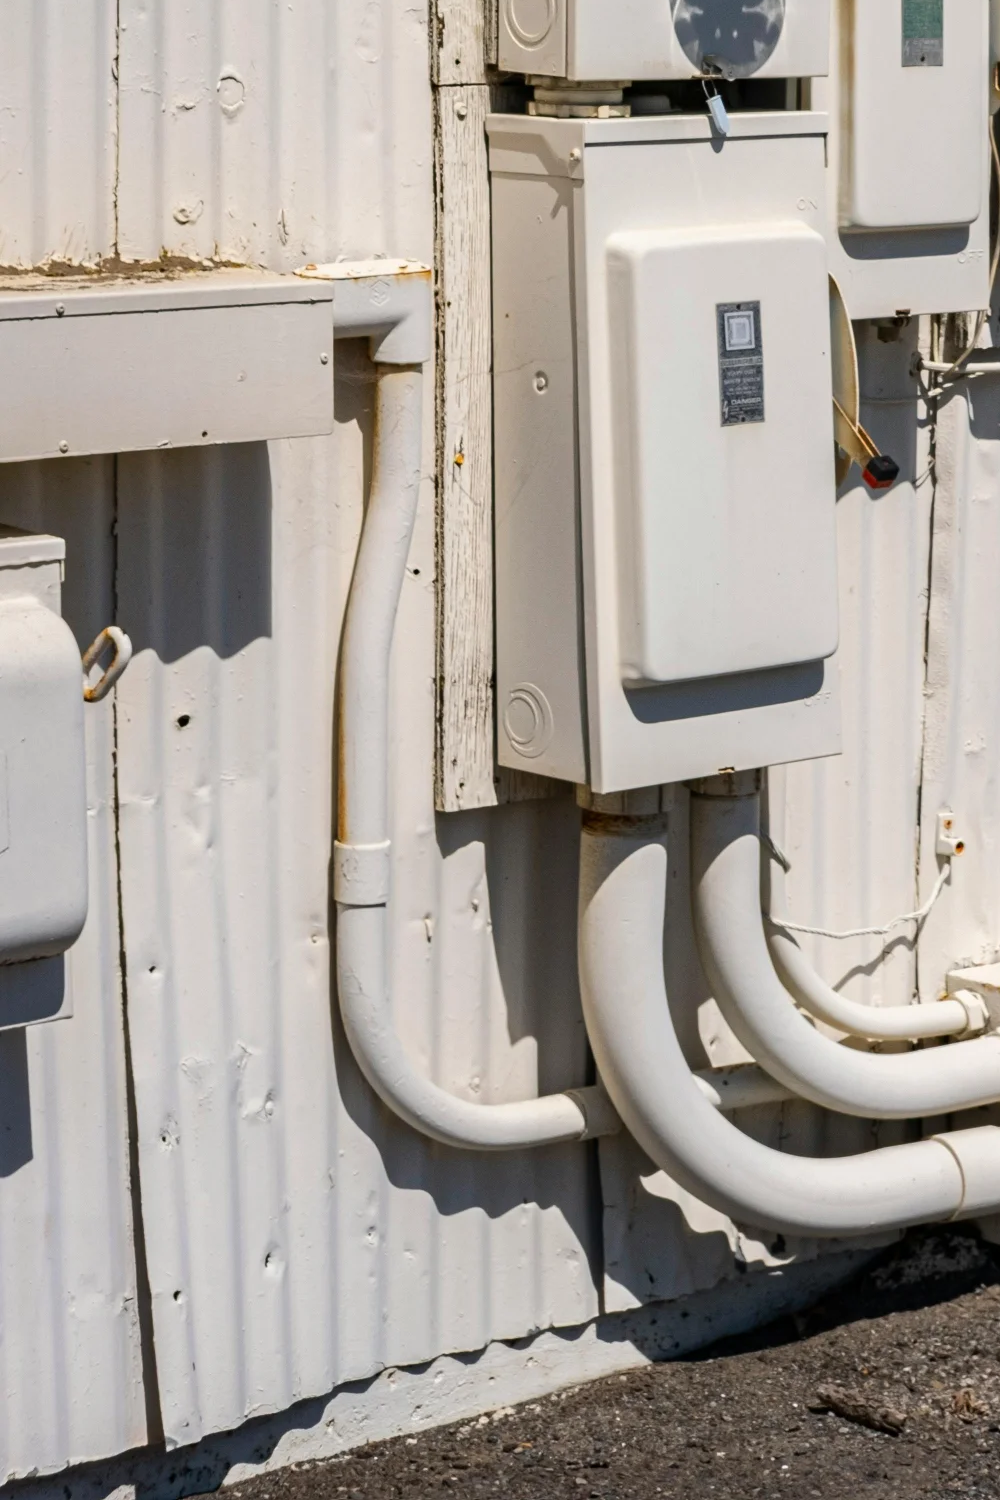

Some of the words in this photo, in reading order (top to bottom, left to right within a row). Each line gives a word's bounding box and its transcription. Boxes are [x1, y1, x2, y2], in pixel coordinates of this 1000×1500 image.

[796, 196, 818, 212] ON
[957, 248, 985, 265] OFF
[731, 397, 762, 406] DANGER
